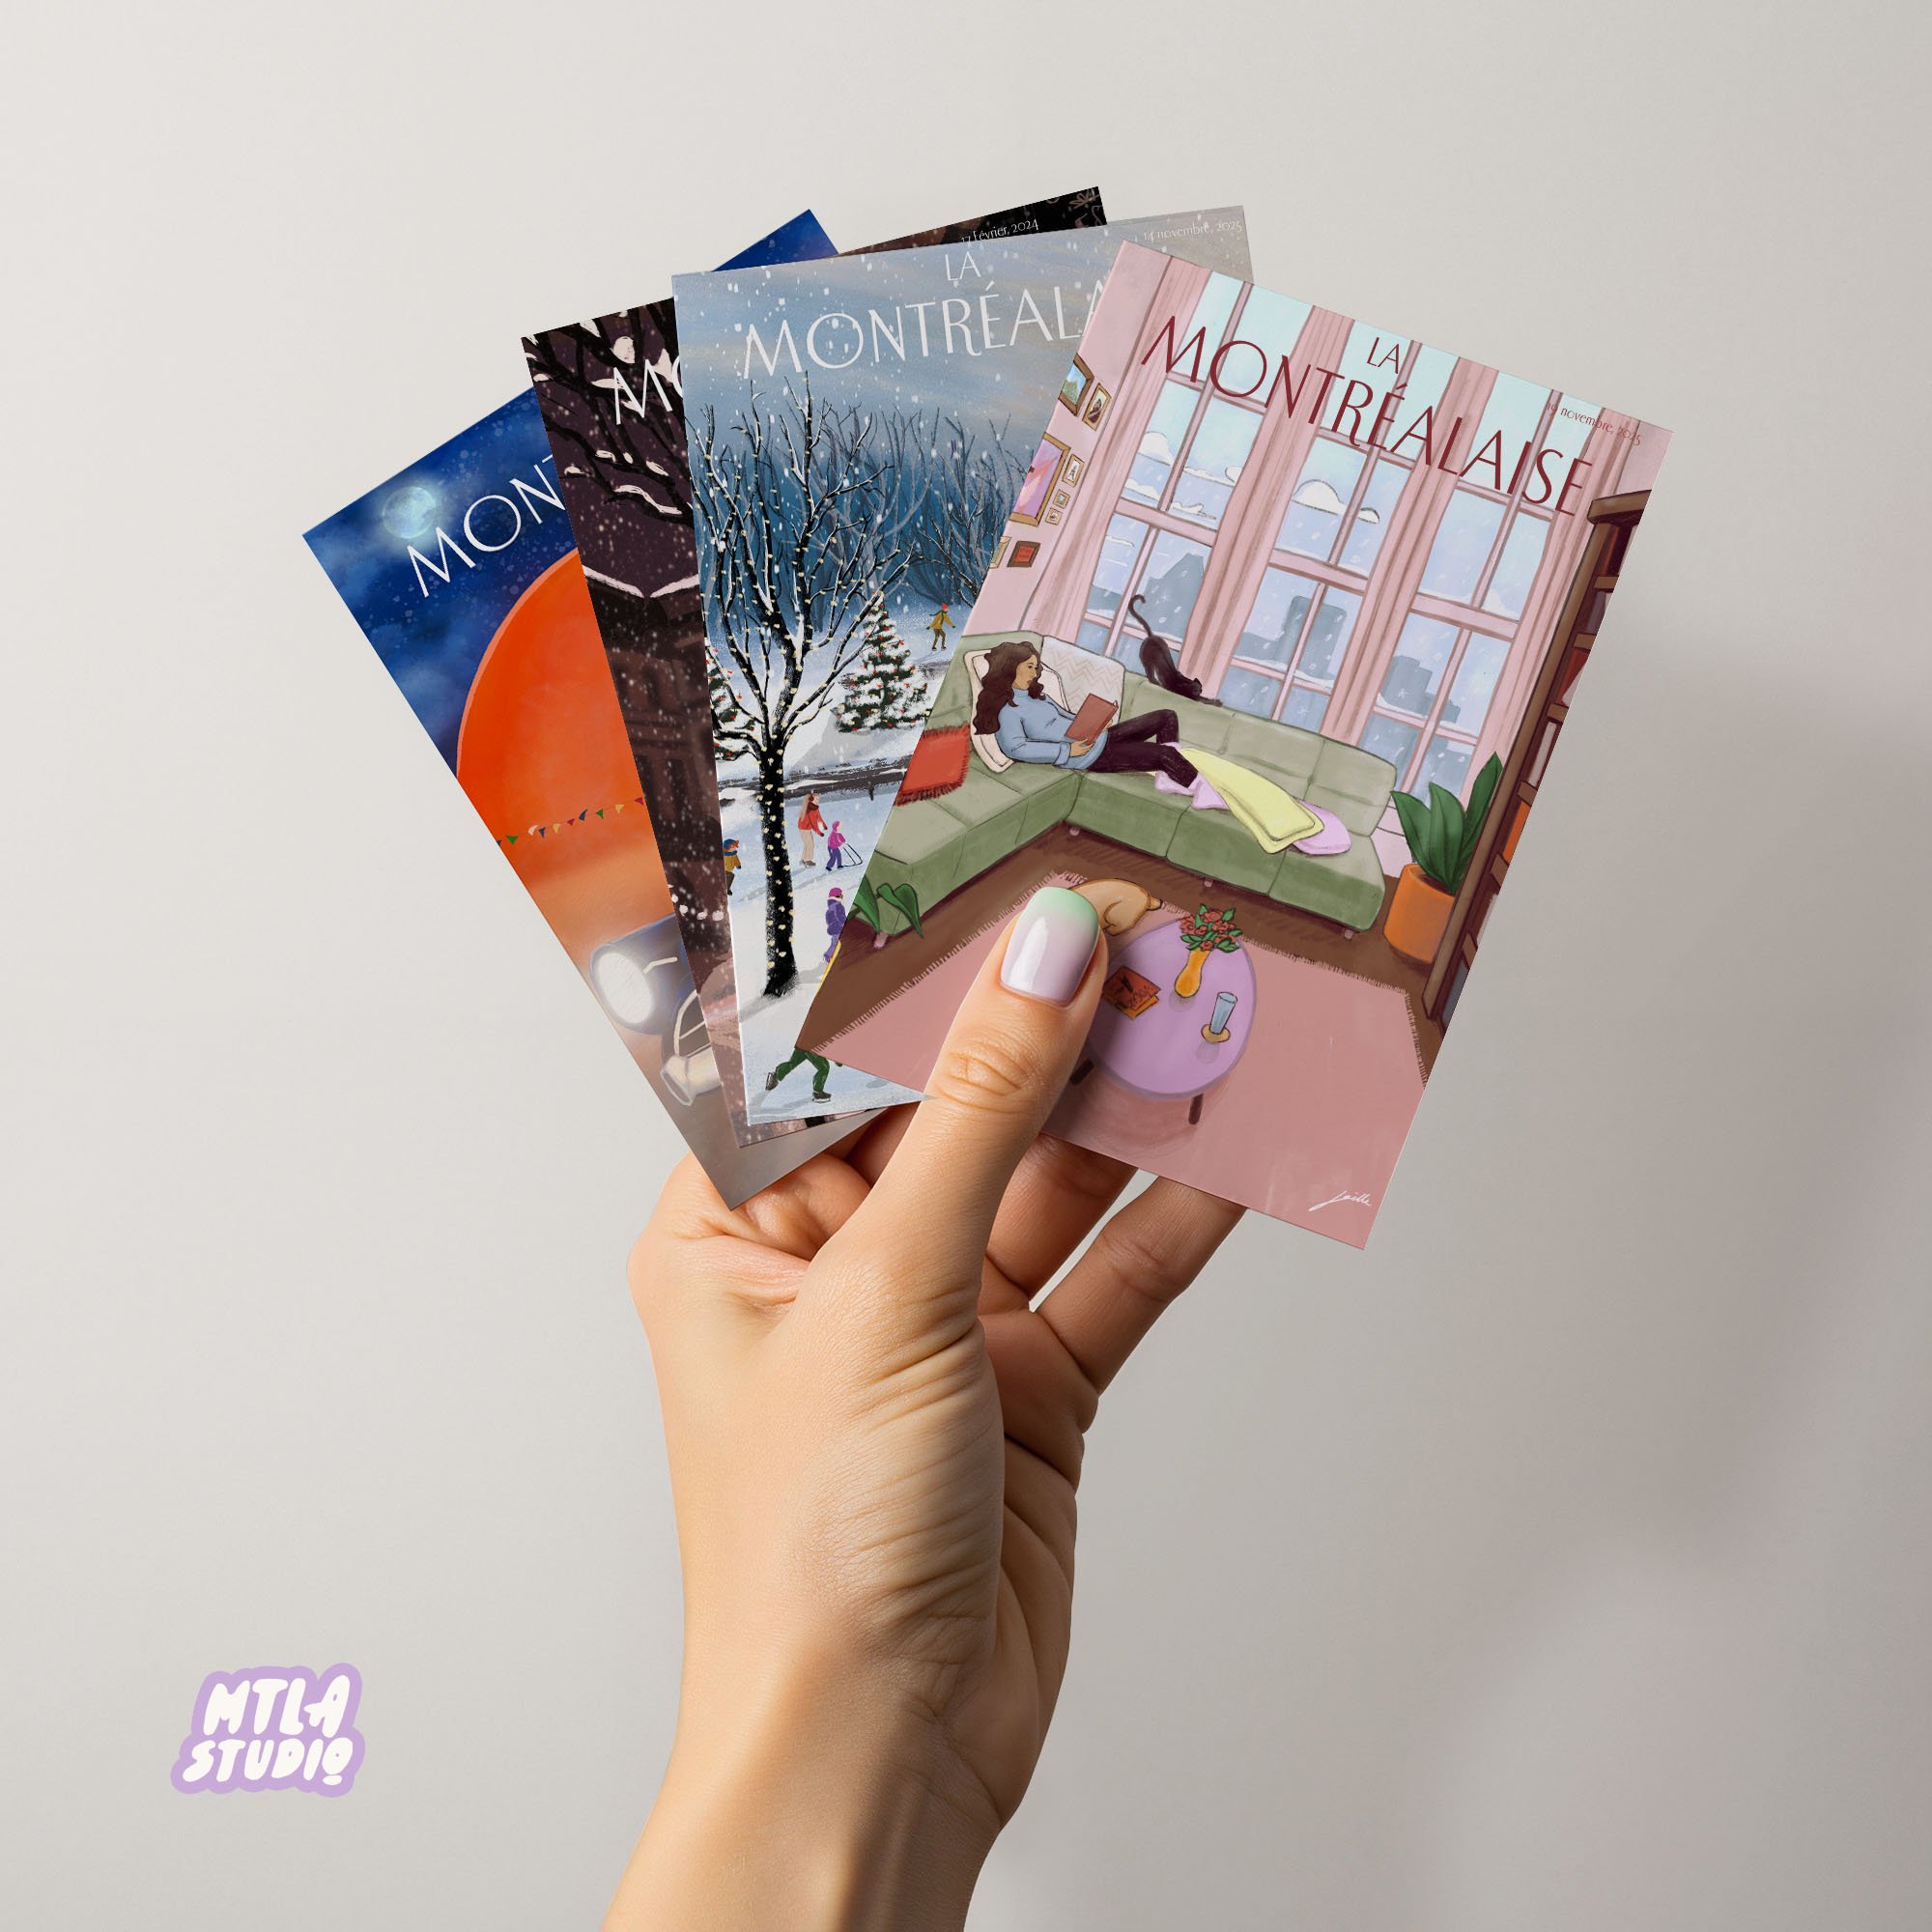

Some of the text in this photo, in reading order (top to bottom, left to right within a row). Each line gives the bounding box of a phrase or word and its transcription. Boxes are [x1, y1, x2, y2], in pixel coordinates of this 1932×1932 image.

[1010, 218, 1039, 232] 2024
[1217, 220, 1242, 233] 2025
[945, 251, 981, 281] LA
[1366, 336, 1401, 375] LA
[612, 355, 683, 425] M
[1141, 315, 1592, 517] MONTRÉALAISE
[1560, 407, 1613, 435] novembre,
[407, 454, 566, 598] MON
